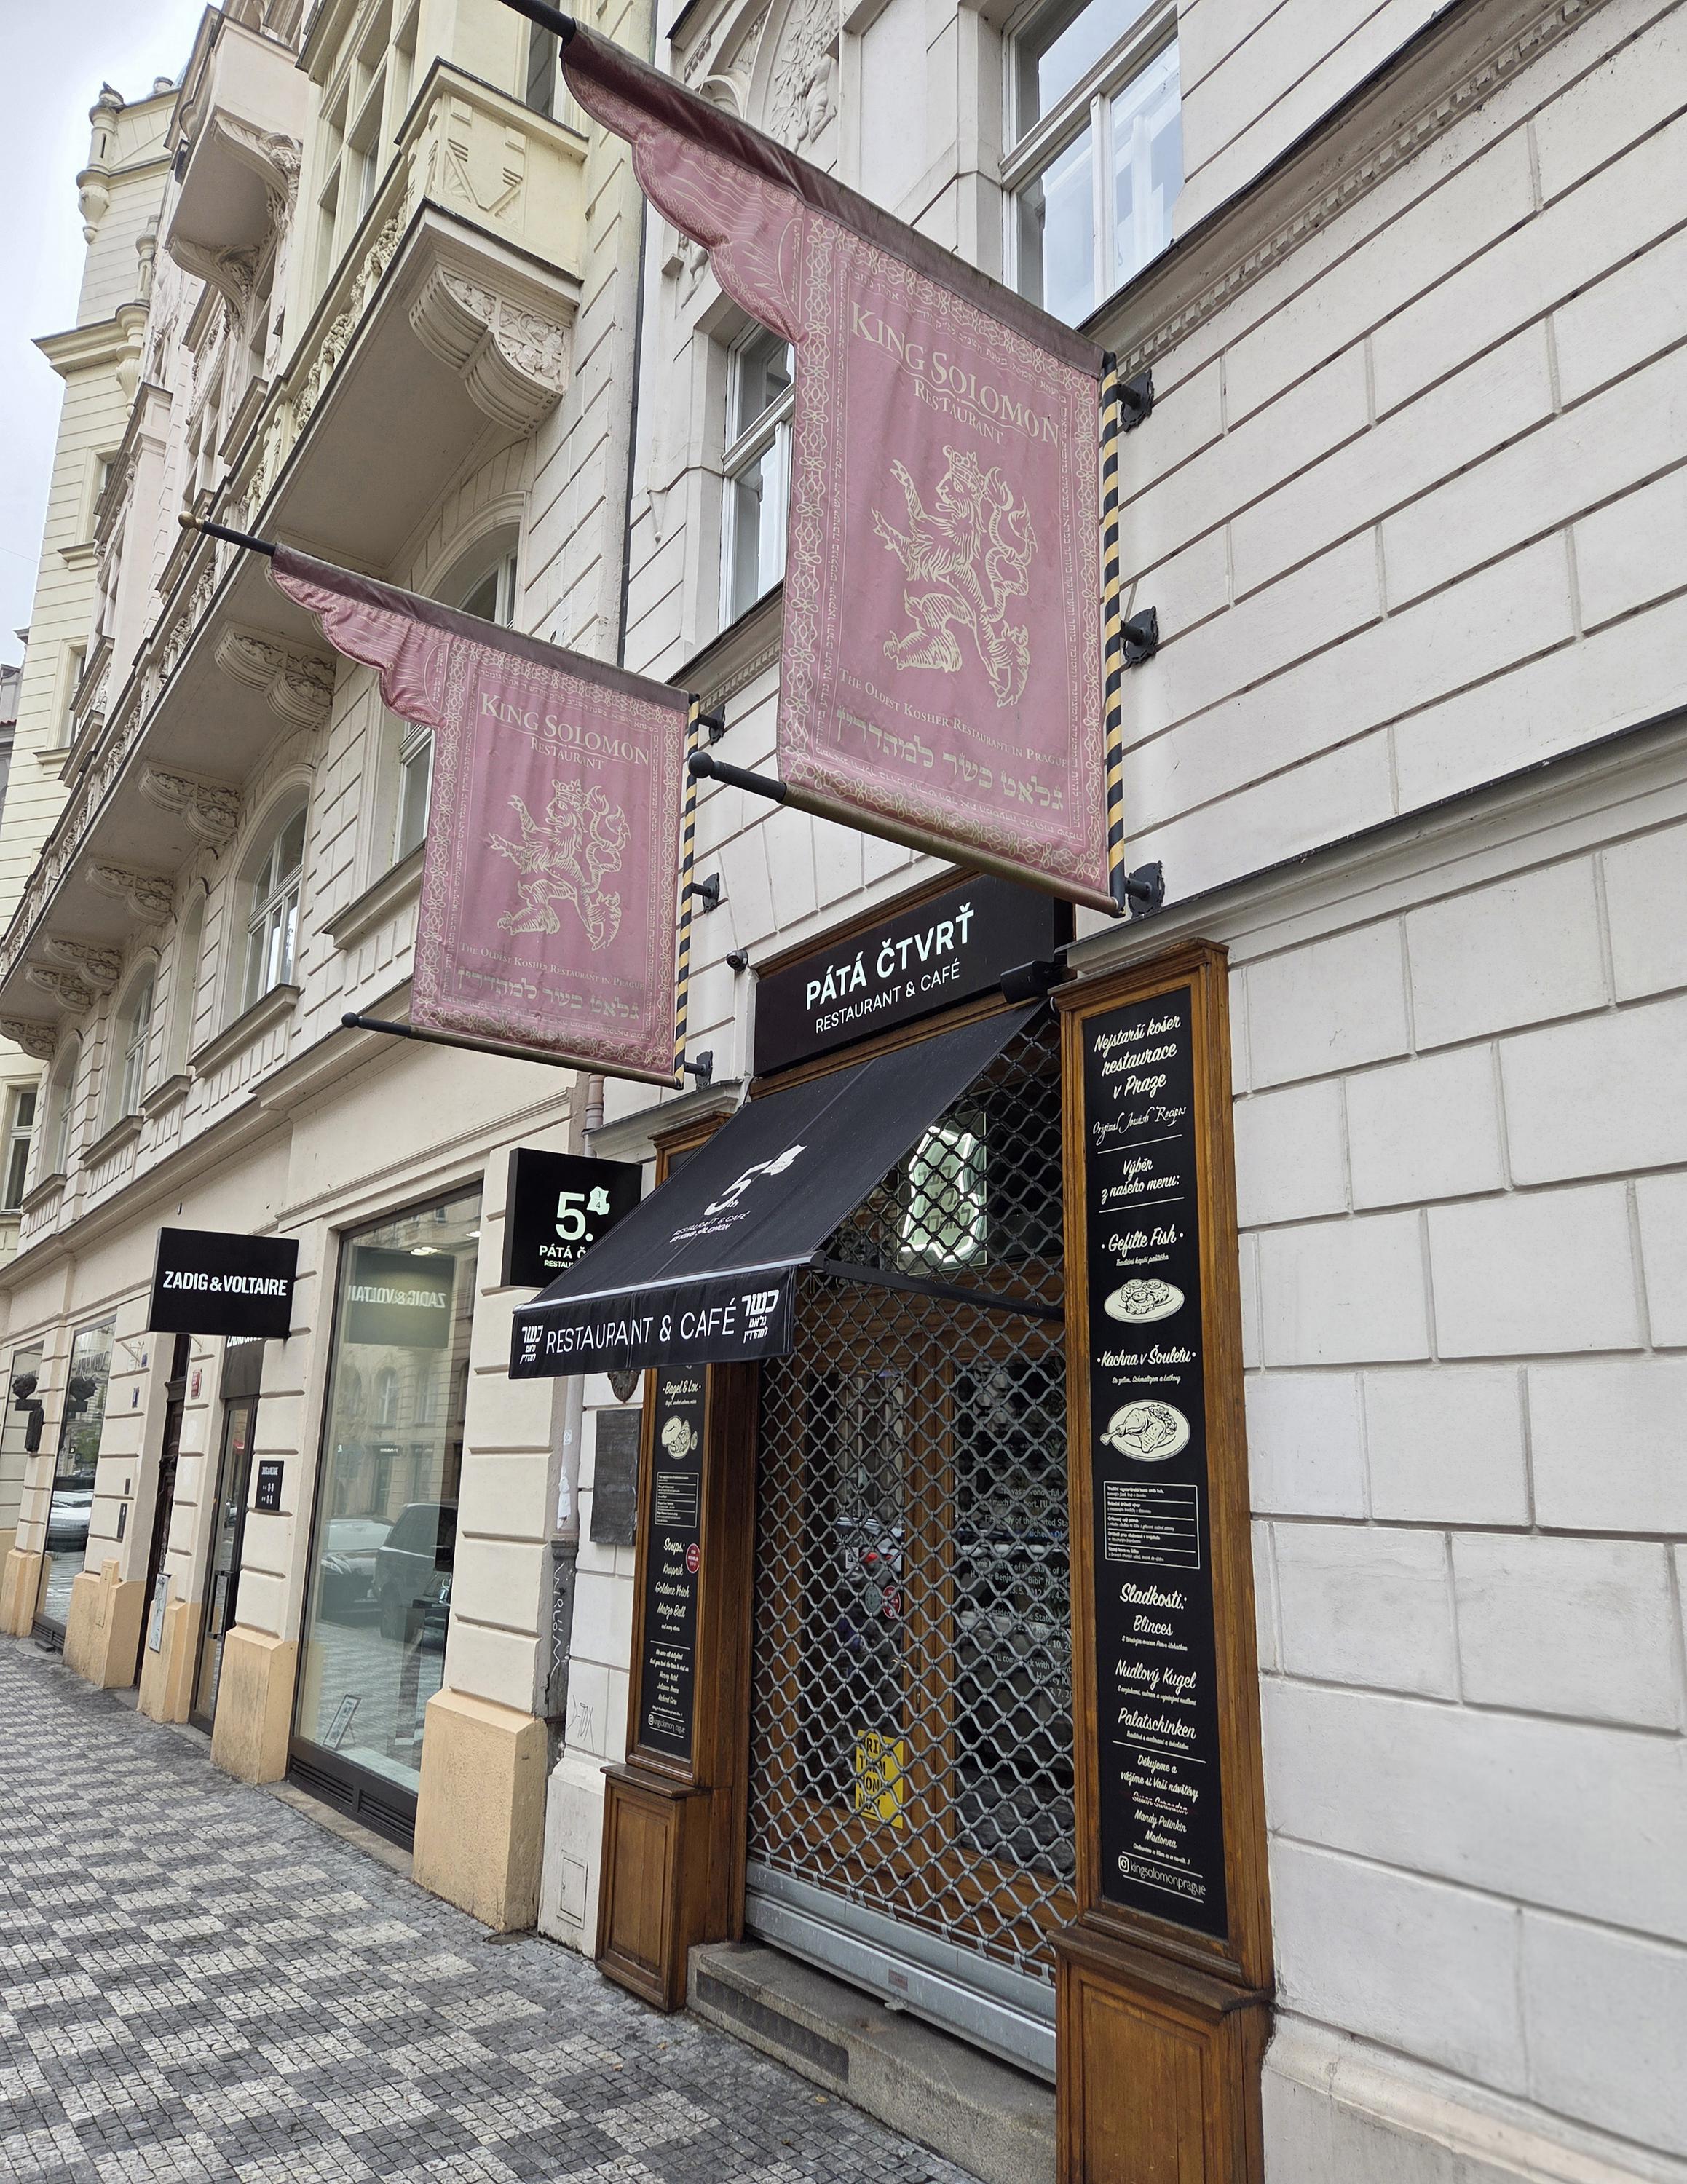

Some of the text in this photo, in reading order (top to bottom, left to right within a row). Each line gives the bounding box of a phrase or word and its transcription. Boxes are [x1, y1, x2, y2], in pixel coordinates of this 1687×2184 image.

[850, 300, 1060, 449] KING SOLOMON
[914, 379, 1006, 445] RESTAURANT
[480, 692, 649, 766] KING SOLOMON
[839, 668, 1068, 769] THE OLDEST KOSHER RESTAURANT IN PRAGUE
[530, 737, 604, 769] RESTAURANT
[943, 751, 995, 789] כשר
[460, 943, 478, 954] THE
[481, 949, 511, 963] OLDEST
[550, 963, 600, 981] RESTAURANT
[601, 976, 611, 984] IN
[613, 977, 644, 990] PRAGUE
[806, 901, 974, 1010] PÁTÁ ČTVRŤ
[542, 986, 583, 1009] כשר
[815, 957, 960, 1034] RESTAURANT & CAFÉ
[1094, 1014, 1181, 1058] Nejstarší košer
[1102, 1042, 1177, 1077] restaurace
[1113, 1072, 1166, 1099] v Praze
[1093, 1111, 1123, 1146] Original
[1155, 1105, 1186, 1127] Recipes
[1123, 1156, 1153, 1182] Výběr
[1101, 1174, 1180, 1205] z našeho menu:
[539, 1243, 573, 1259] PÁTÁ
[1108, 1224, 1177, 1258] Gefilte Fish
[544, 1259, 574, 1269] RESTAU
[741, 1289, 780, 1317] כשר
[521, 1325, 544, 1344] כשר
[546, 1297, 737, 1355] RESTAURANT & CAFÉ
[1101, 1344, 1192, 1368] Kachna v Šouletu
[665, 1379, 698, 1400] Bagel & Lox
[1119, 1583, 1188, 1610] Sladkosti:
[1132, 1614, 1174, 1637] Blinces
[1115, 1658, 1161, 1691] Nudlový
[1163, 1666, 1198, 1696] Kugel
[1118, 1707, 1197, 1740] Palatschinken
[1137, 1754, 1177, 1775] Děkujeme a
[1168, 1781, 1199, 1803] návštěvy
[1134, 1808, 1158, 1829] Mandy
[1145, 1829, 1177, 1849] Madonna
[1130, 1860, 1206, 1896] kingsolomonprague
